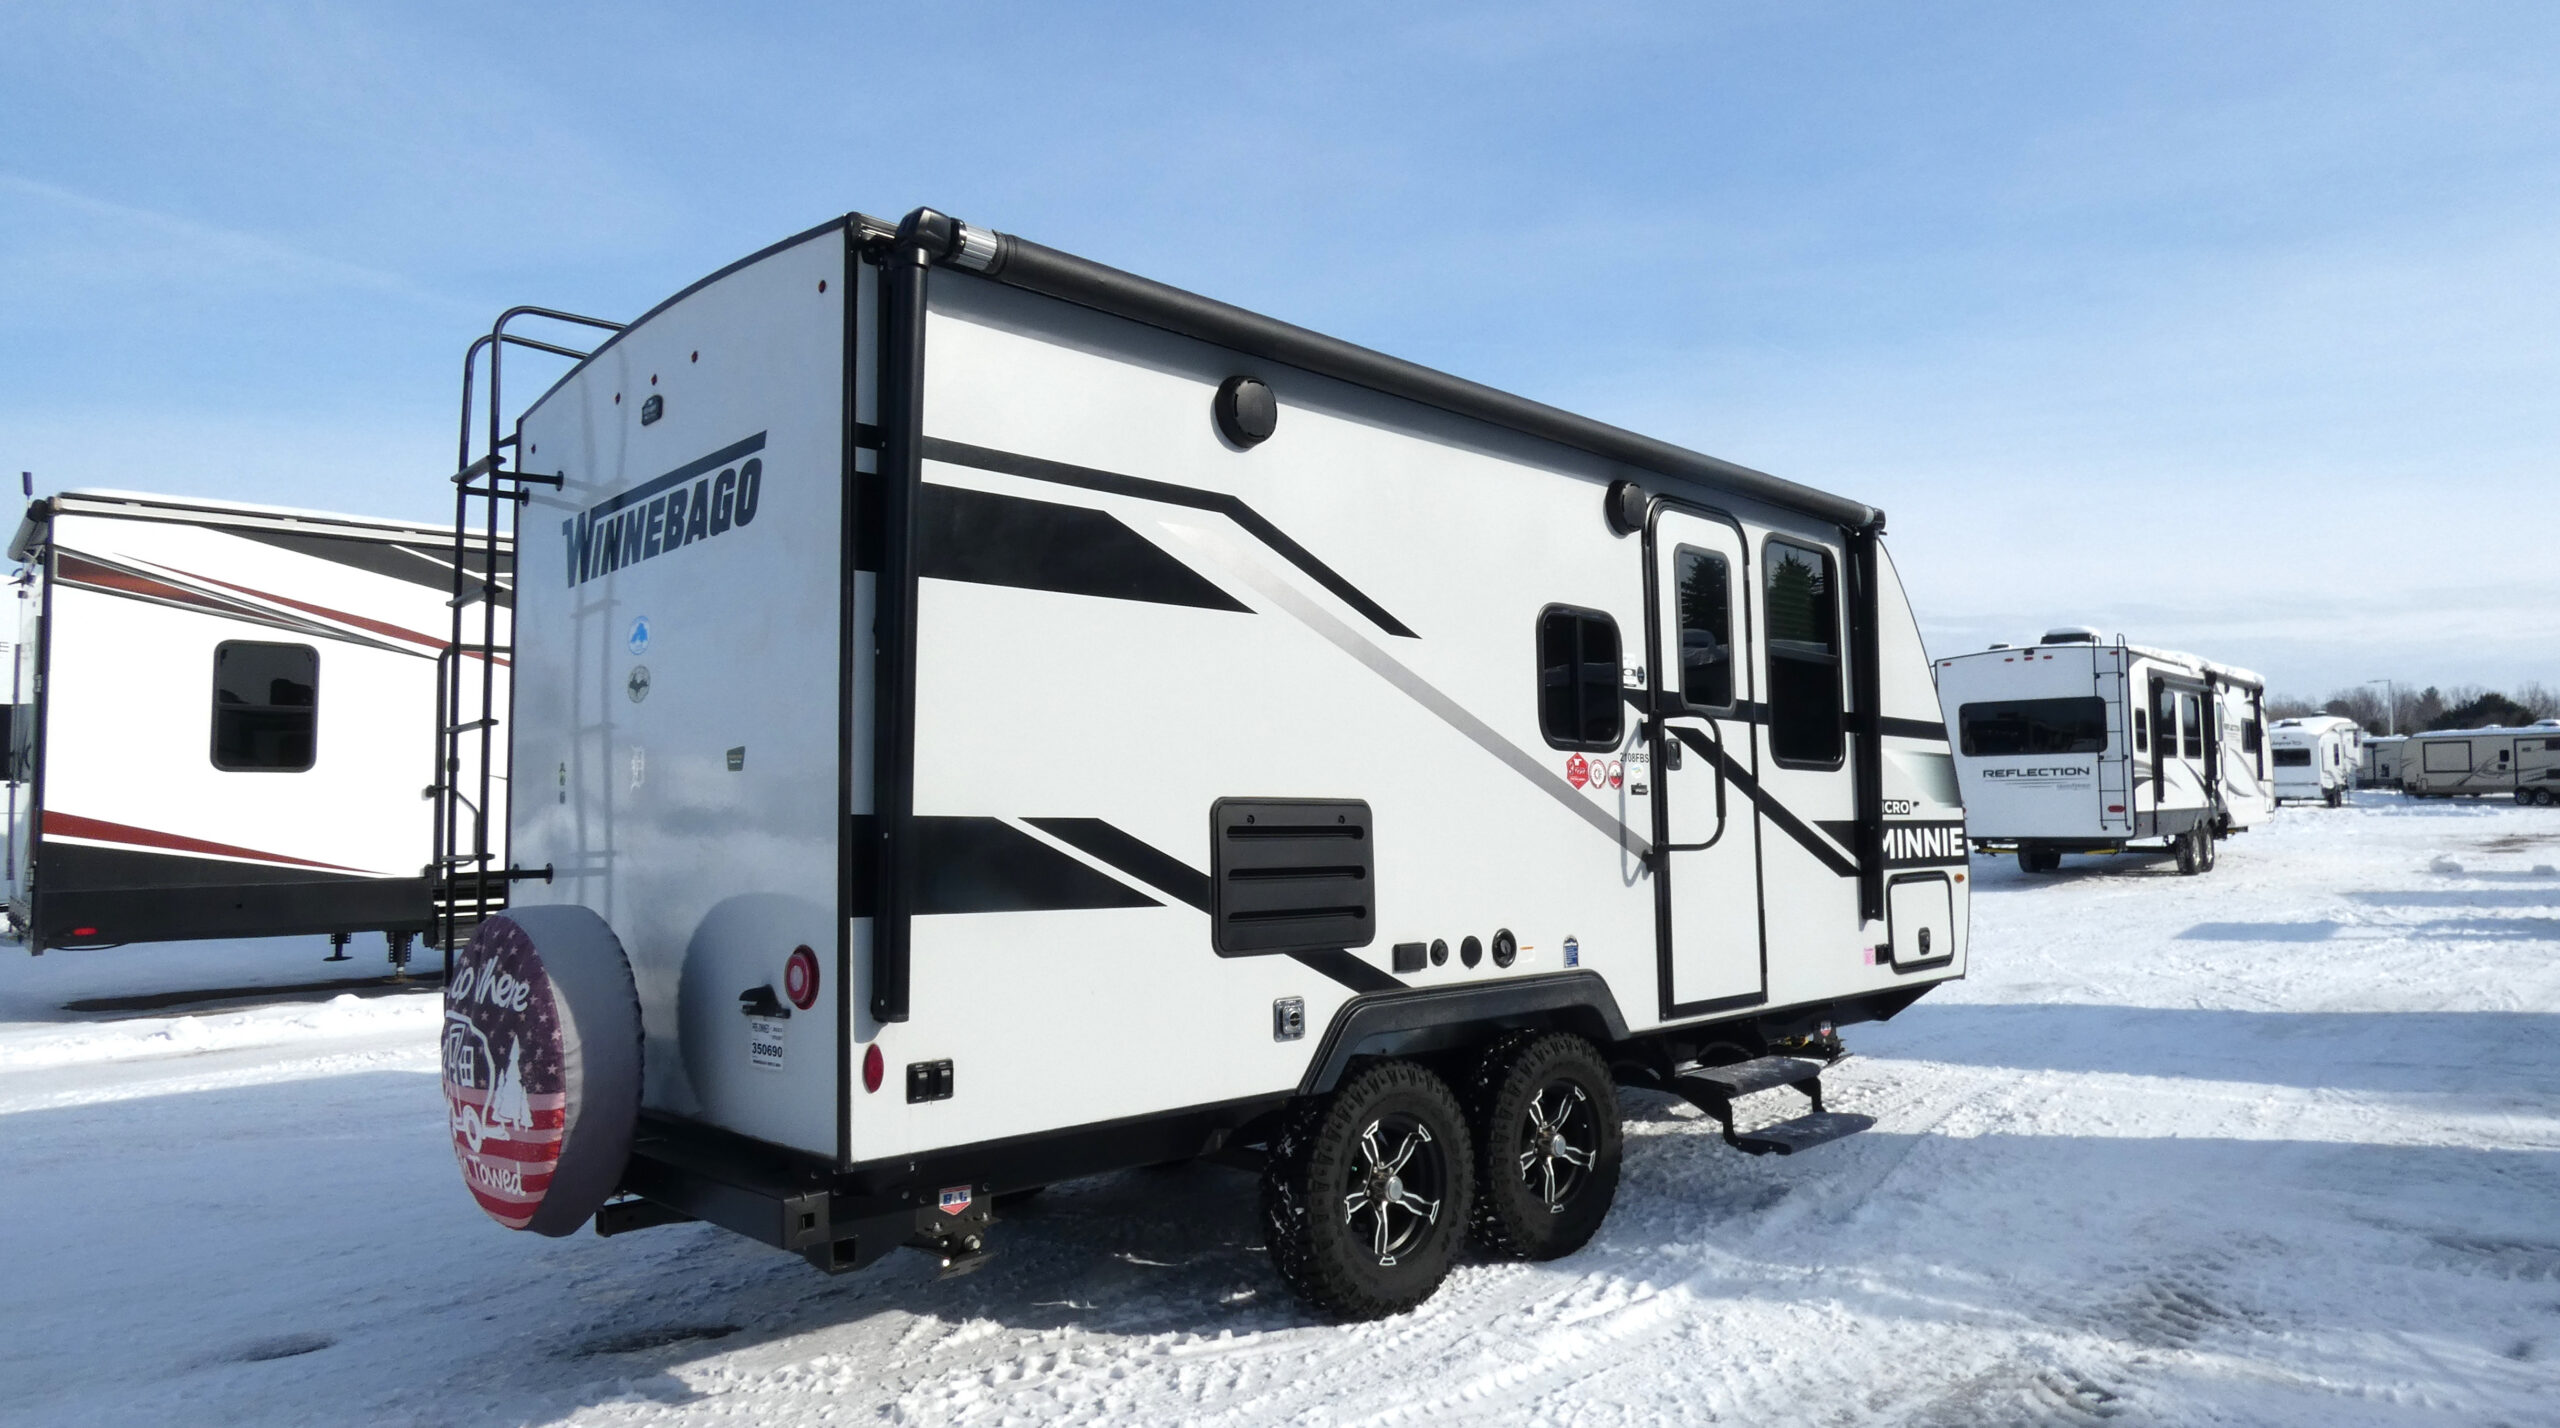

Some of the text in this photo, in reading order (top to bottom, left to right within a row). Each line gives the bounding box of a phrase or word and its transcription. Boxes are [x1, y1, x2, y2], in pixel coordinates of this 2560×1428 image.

[562, 448, 764, 589] WINNEBAGO
[1983, 766, 2090, 778] REFLECTION
[752, 1042, 783, 1058] 350690
[468, 1154, 527, 1197] Towed
